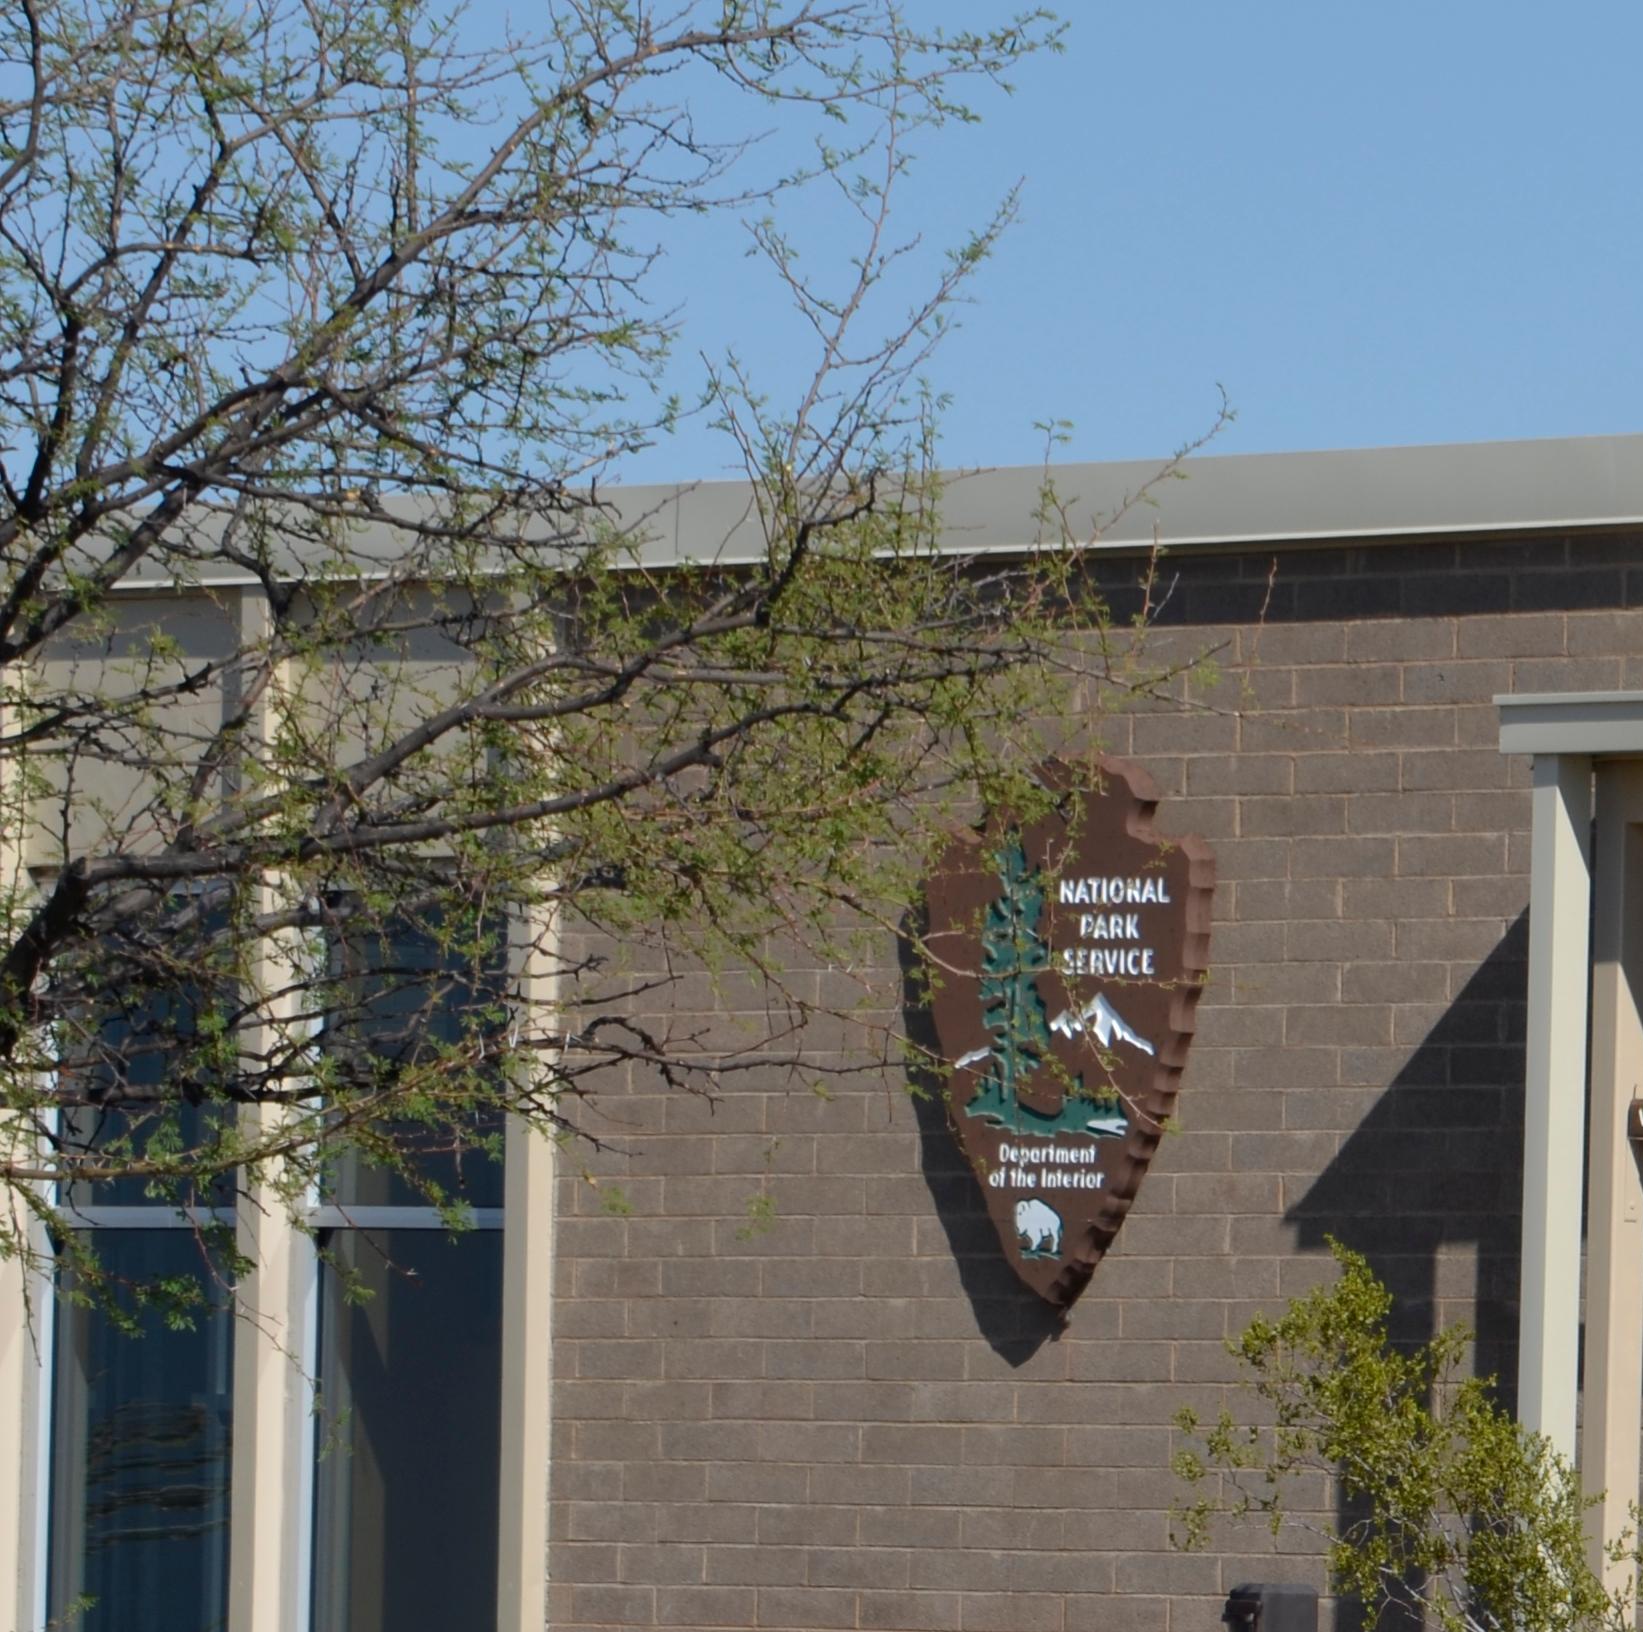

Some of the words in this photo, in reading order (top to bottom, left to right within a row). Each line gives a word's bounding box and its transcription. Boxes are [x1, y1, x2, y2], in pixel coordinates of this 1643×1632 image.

[1059, 877, 1171, 904] NATIONAL
[1080, 913, 1139, 939] PARK
[1062, 948, 1155, 975] SERVICE
[999, 1142, 1096, 1168] Department
[989, 1167, 1007, 1188] of
[1010, 1167, 1037, 1188] the
[1041, 1168, 1105, 1189] Interior
